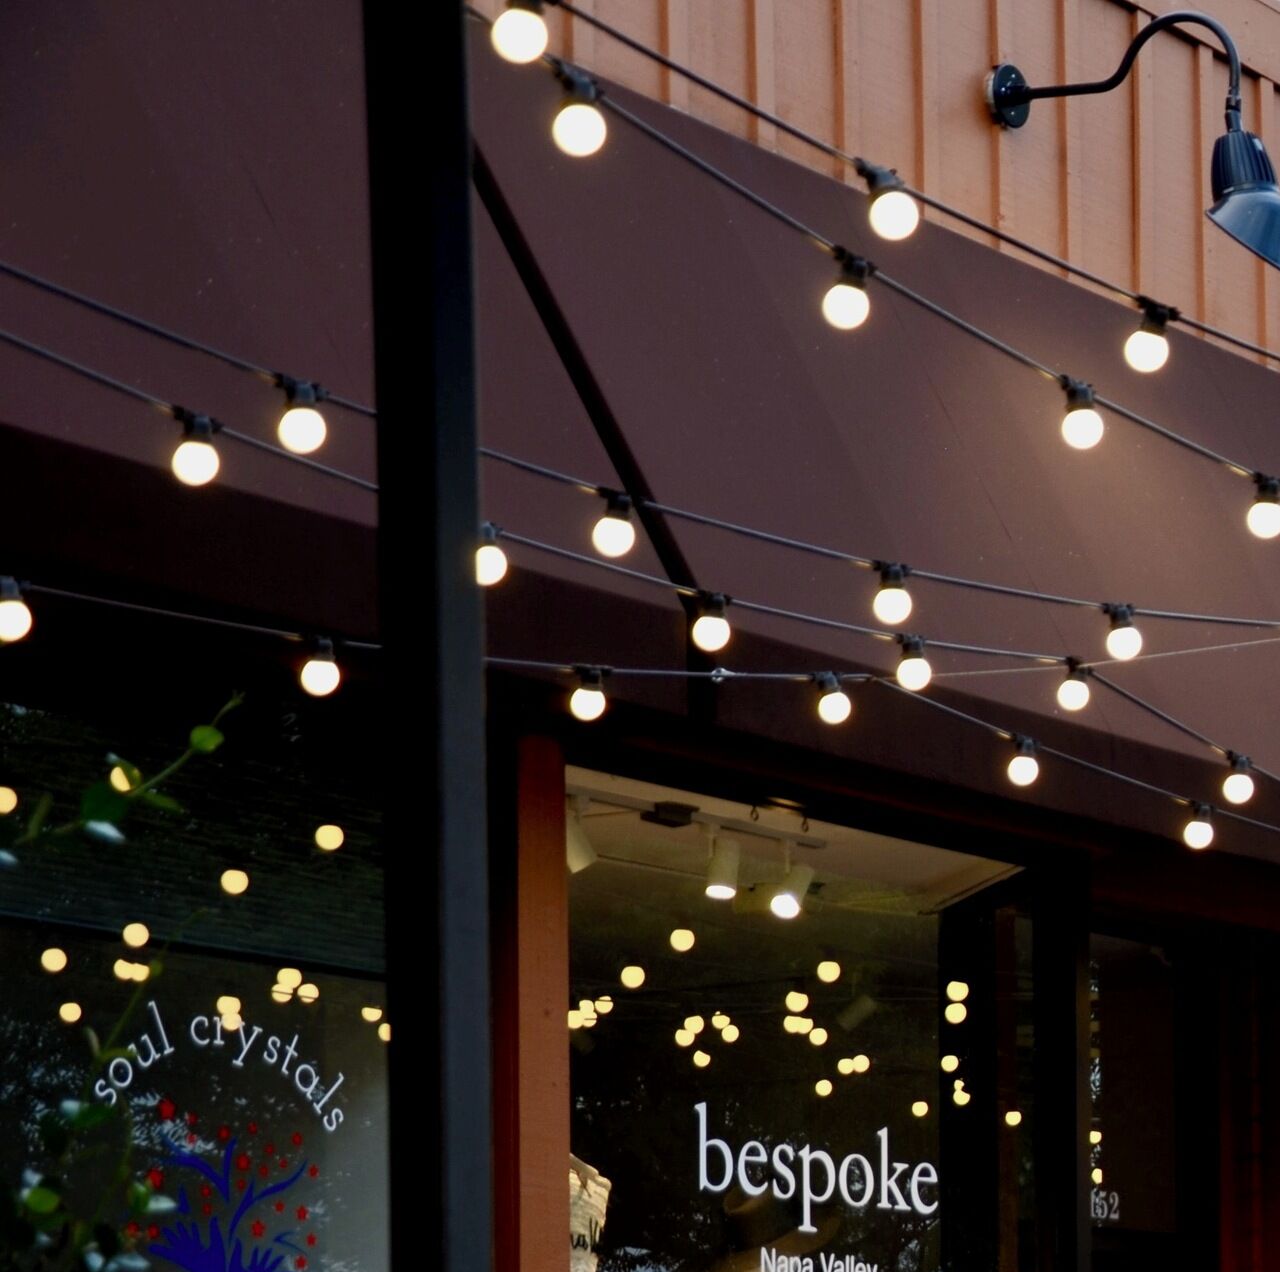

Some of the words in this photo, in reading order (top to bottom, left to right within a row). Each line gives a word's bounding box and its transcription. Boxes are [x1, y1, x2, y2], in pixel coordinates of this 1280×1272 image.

[94, 1000, 174, 1106] soul
[190, 1015, 345, 1133] crystals
[694, 1101, 939, 1234] bespoke
